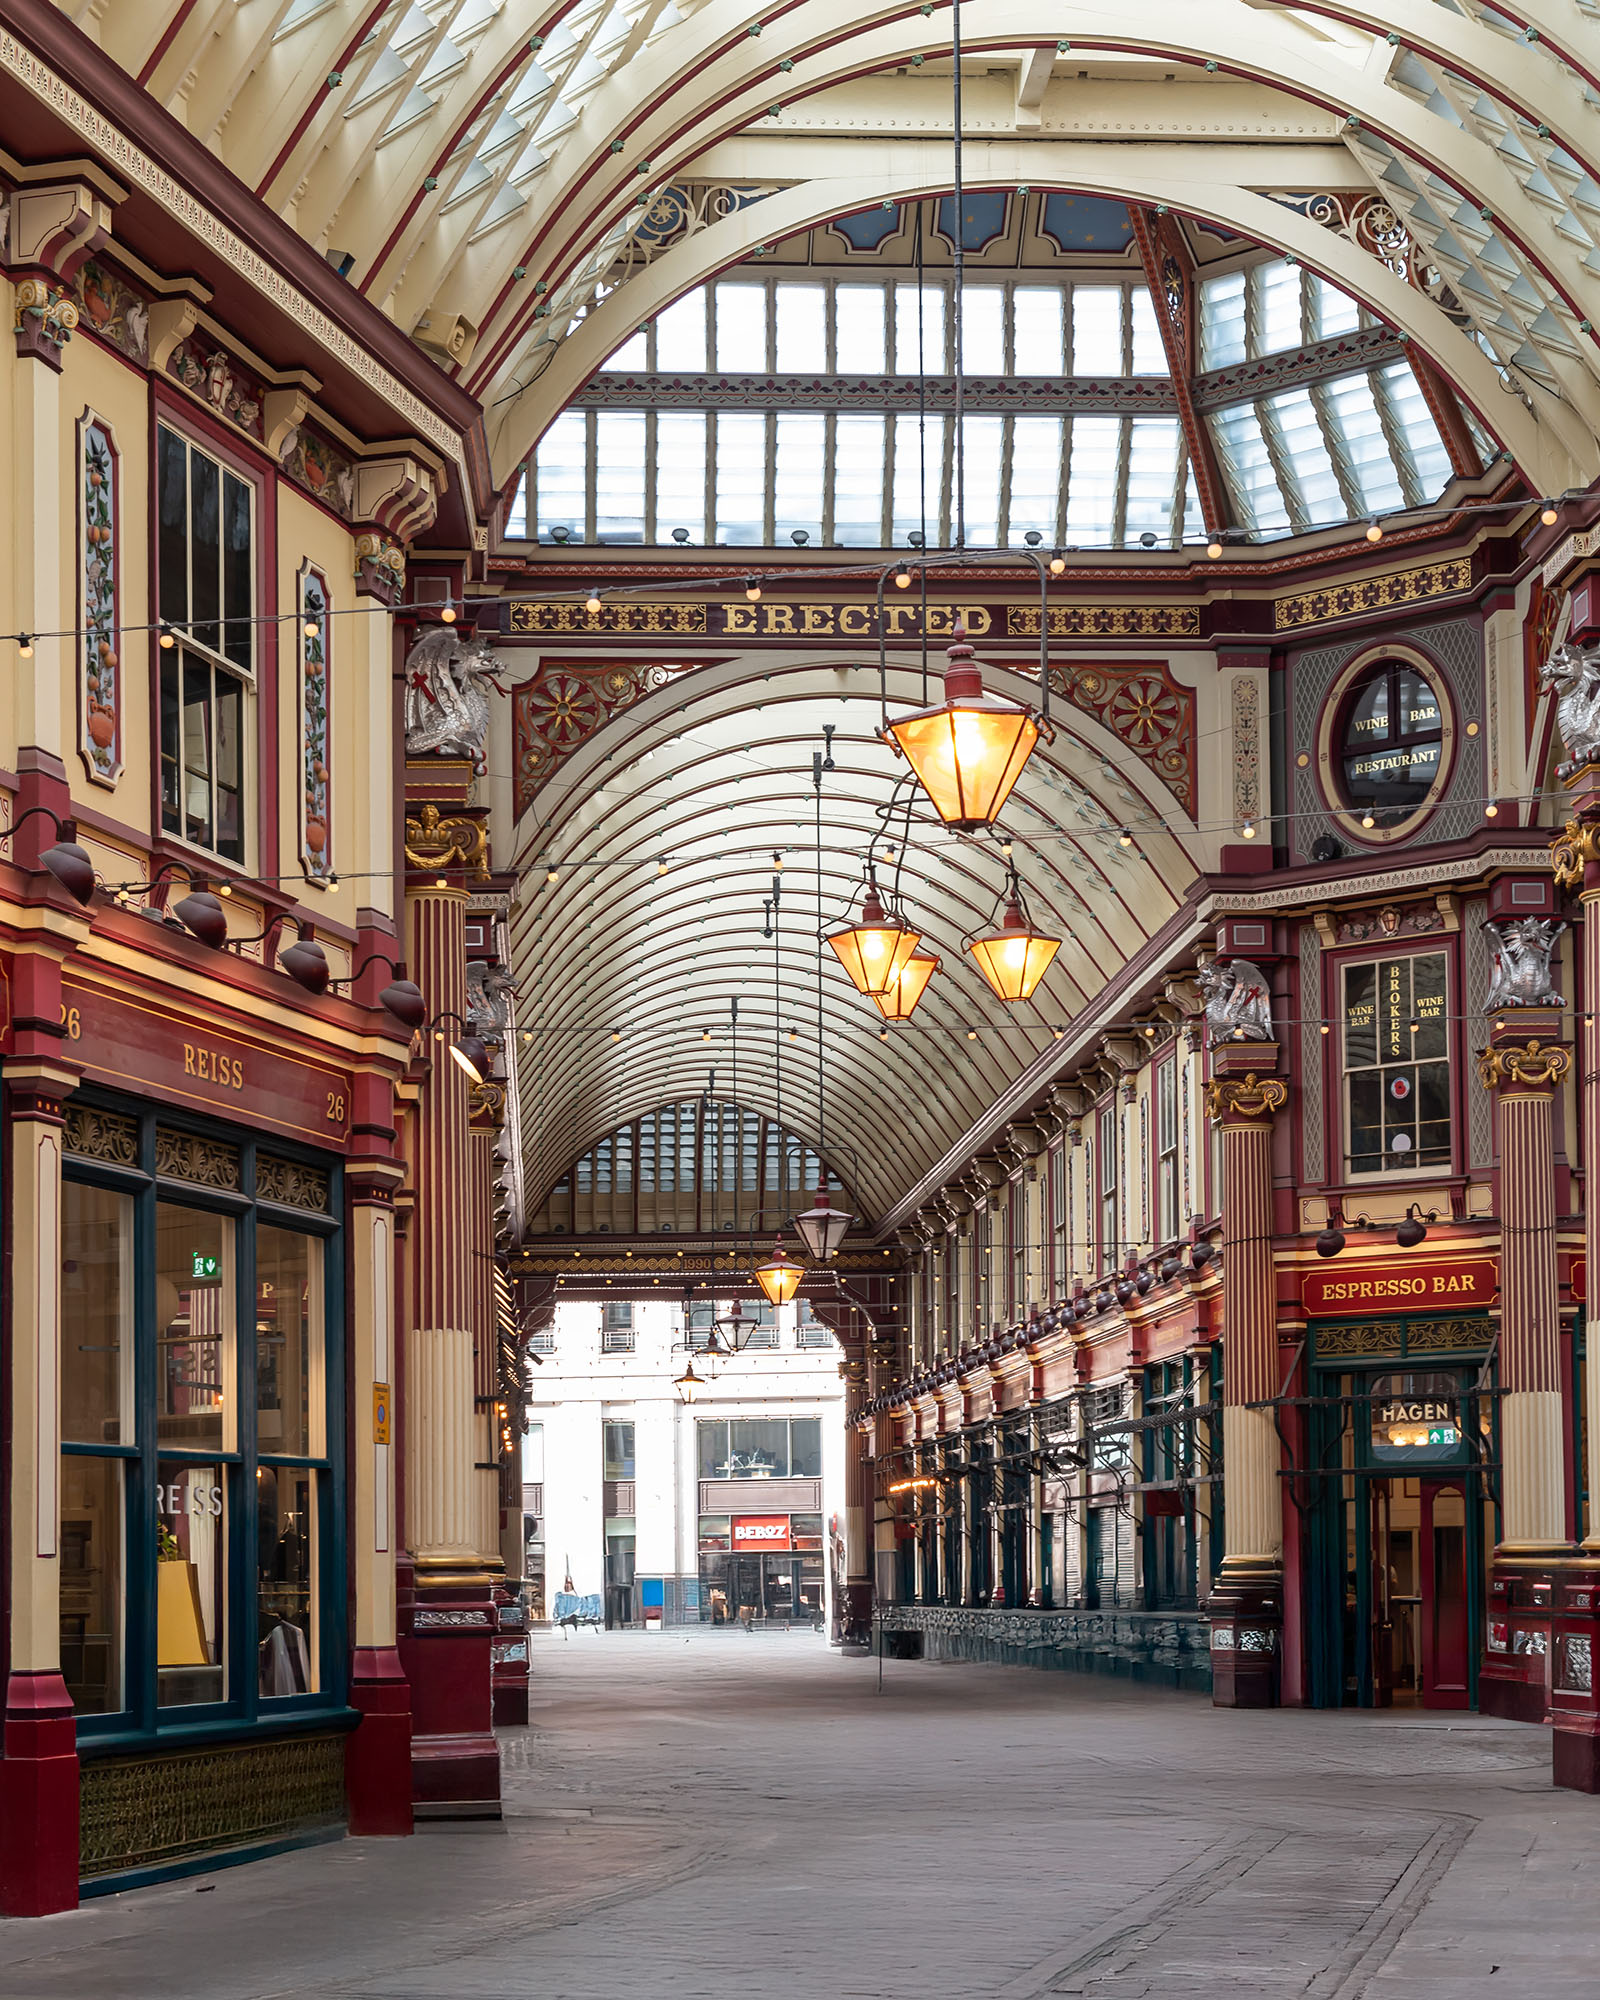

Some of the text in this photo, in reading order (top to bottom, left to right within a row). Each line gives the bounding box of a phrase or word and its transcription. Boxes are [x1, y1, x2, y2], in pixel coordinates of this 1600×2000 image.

[721, 604, 992, 635] ERECTED
[1355, 706, 1436, 732] WINE BAR
[1355, 749, 1437, 775] RESTAURANT
[1347, 1005, 1375, 1017] WINE
[1390, 966, 1401, 1056] BROKERS
[1416, 996, 1444, 1008] WINE
[1420, 1007, 1440, 1018] BAR
[1351, 1016, 1370, 1027] BAR
[184, 1043, 243, 1089] REISS
[326, 1092, 344, 1121] 26
[683, 1258, 711, 1270] 1990
[1322, 1275, 1475, 1300] ESPRESSO BAR
[1382, 1403, 1449, 1422] HAGEN
[157, 1484, 221, 1516] REISS
